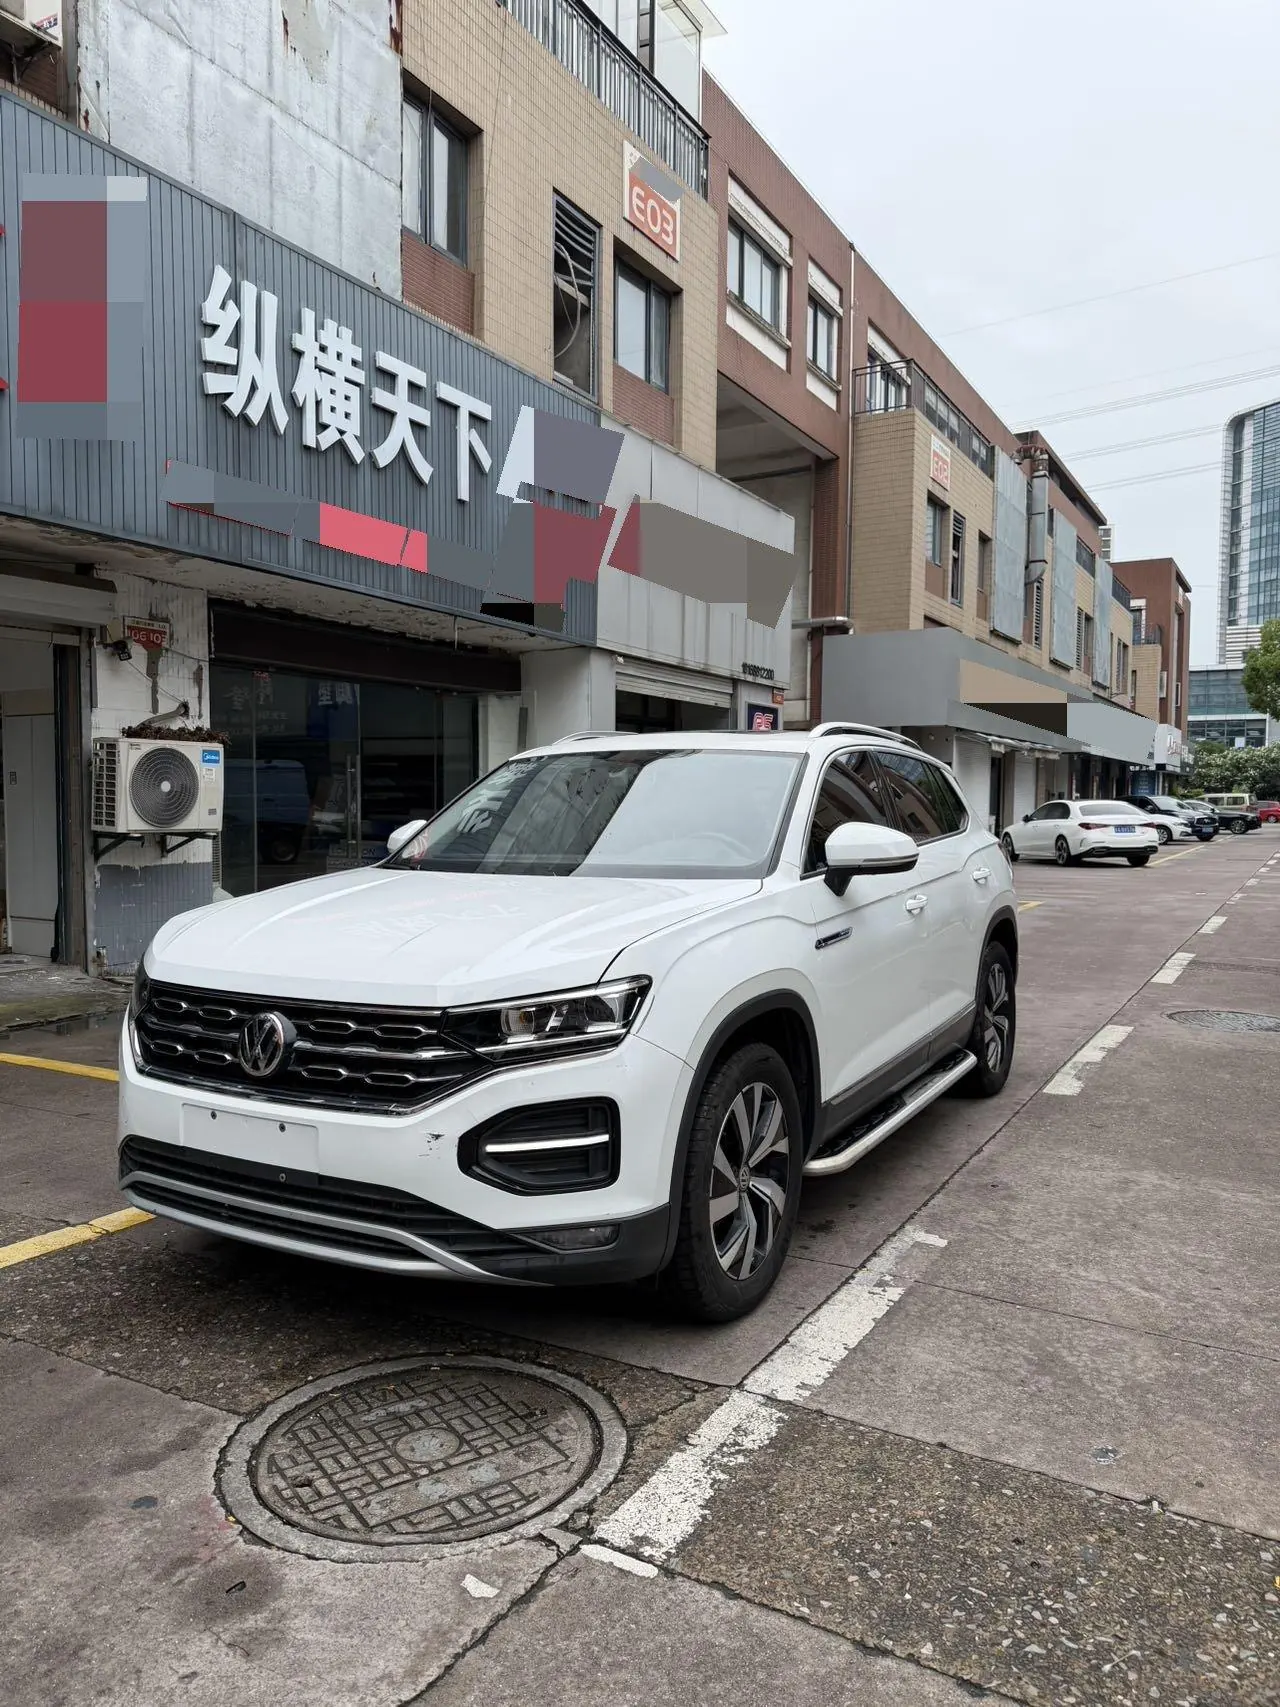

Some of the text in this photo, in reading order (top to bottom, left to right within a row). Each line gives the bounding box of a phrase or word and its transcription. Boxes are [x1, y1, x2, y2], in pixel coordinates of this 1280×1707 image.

[632, 185, 674, 245] E03
[200, 264, 493, 503] 纵横天下
